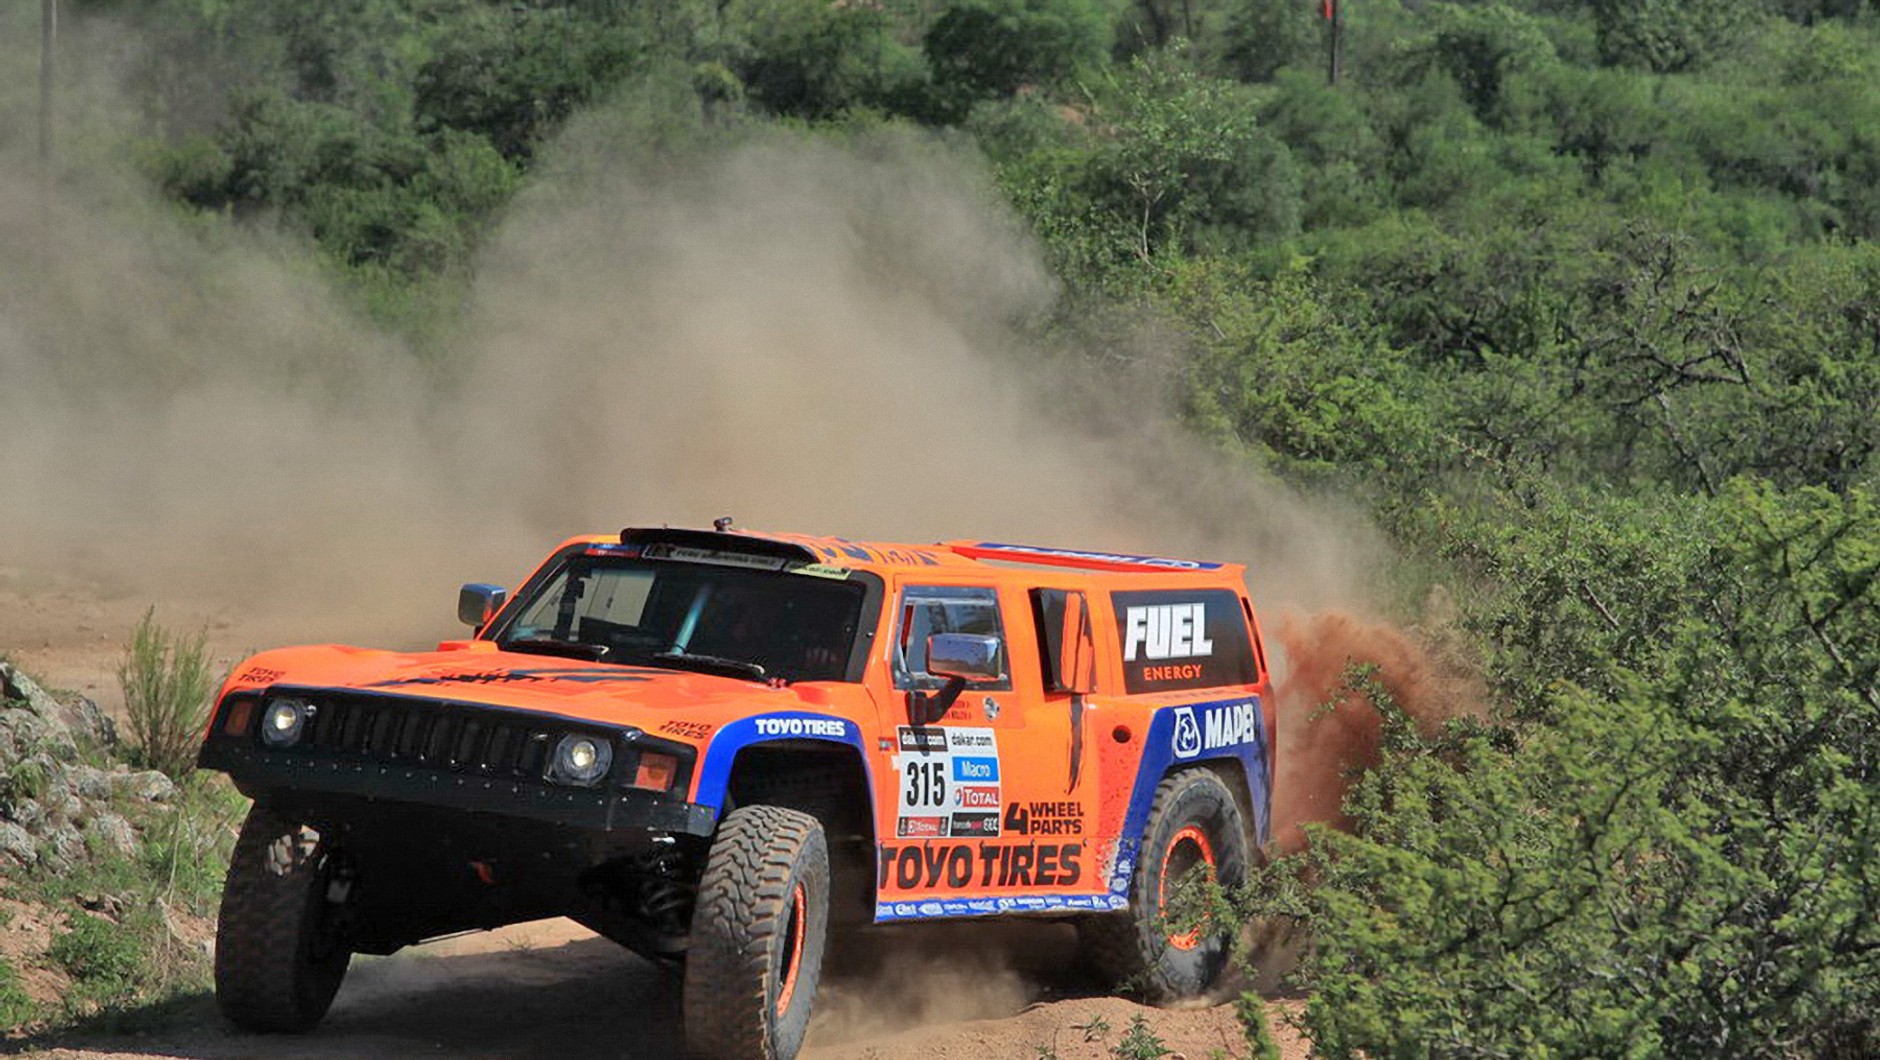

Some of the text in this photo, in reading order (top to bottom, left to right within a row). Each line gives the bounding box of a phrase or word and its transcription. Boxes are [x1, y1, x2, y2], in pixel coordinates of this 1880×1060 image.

[1124, 602, 1213, 661] FUEL
[1143, 664, 1202, 681] ENERGY
[659, 725, 708, 740] TIRES
[665, 720, 712, 731] TOYO
[754, 718, 845, 737] TOYO TIRES
[906, 761, 946, 806] 315
[965, 788, 999, 805] TOTAL
[1004, 802, 1028, 836] 4
[1029, 802, 1085, 818] WHEEL
[1030, 819, 1083, 835] PARTS
[879, 843, 1083, 890] TOYO TIRES
